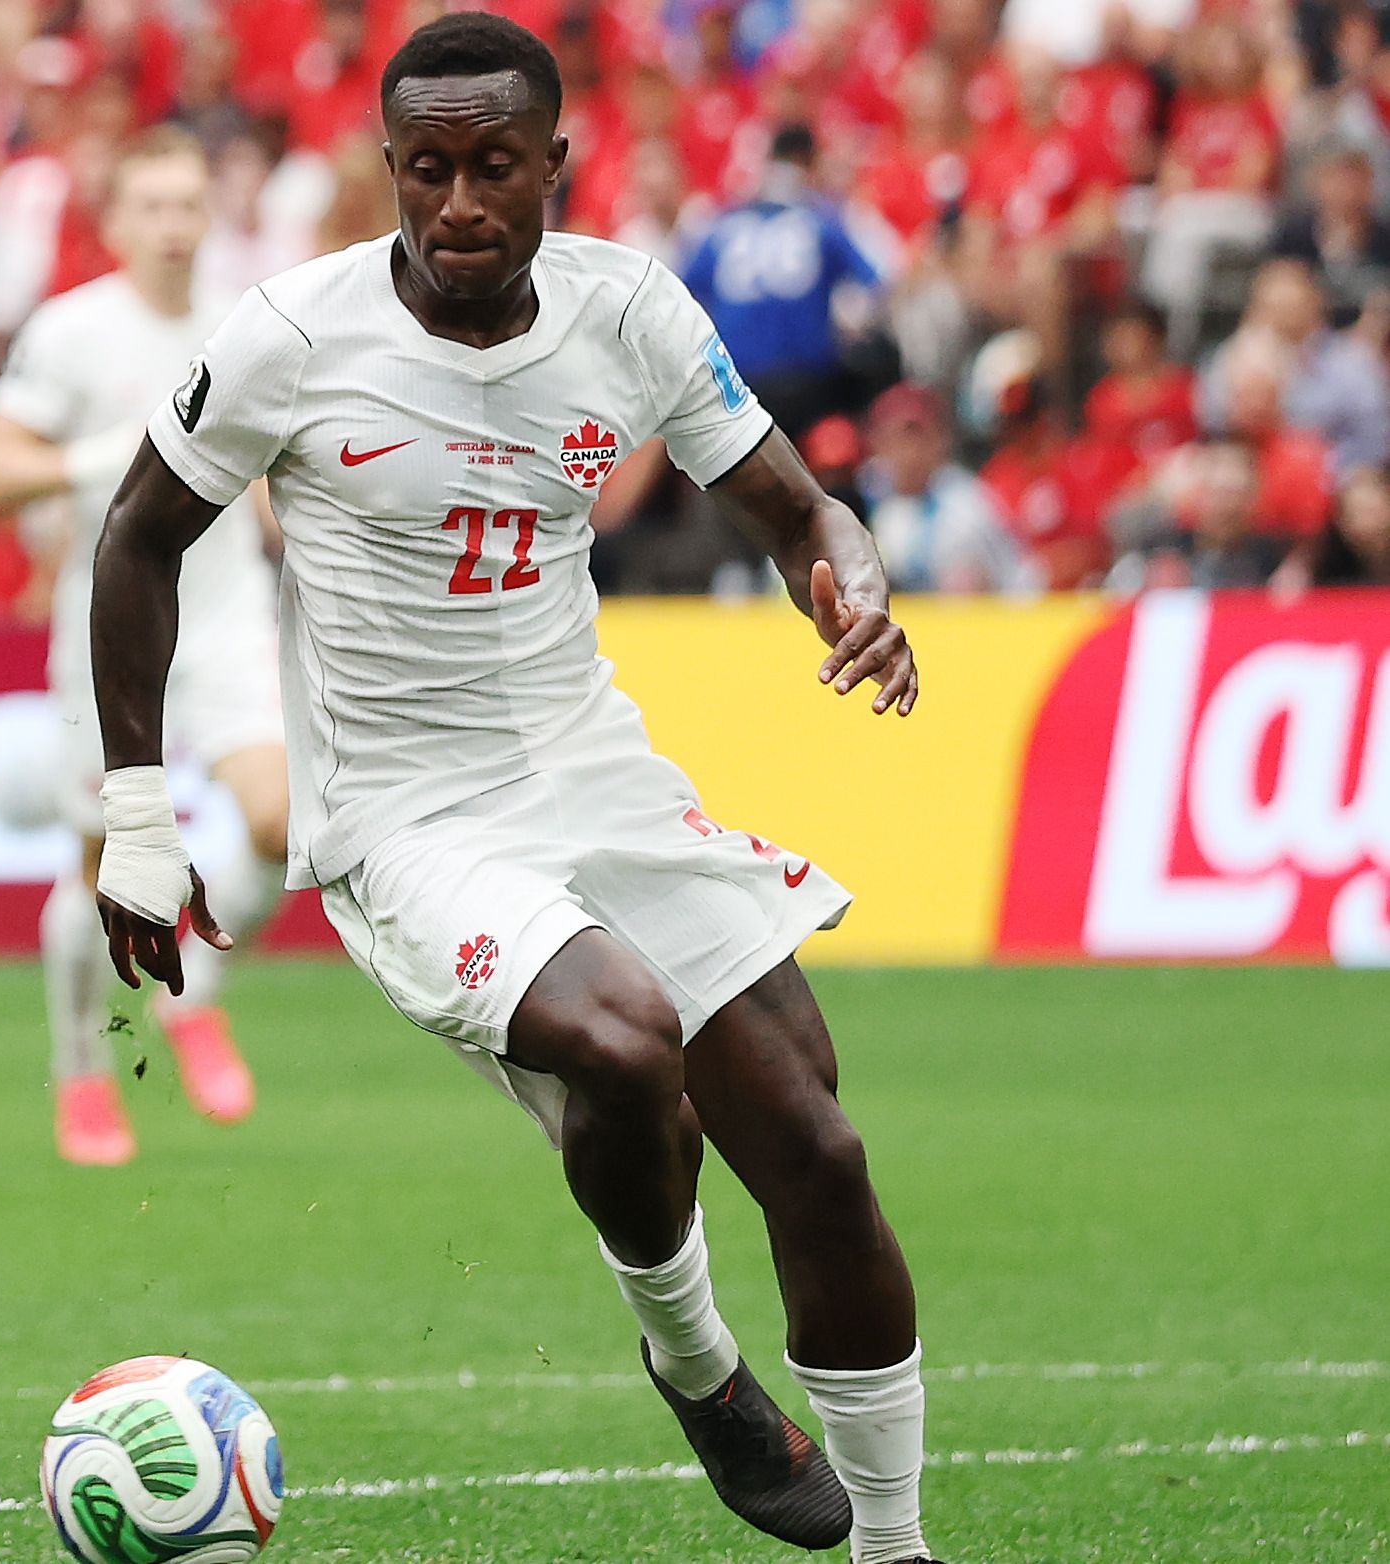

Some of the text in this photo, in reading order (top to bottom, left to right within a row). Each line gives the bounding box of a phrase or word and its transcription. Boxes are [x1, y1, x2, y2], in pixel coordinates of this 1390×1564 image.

[560, 449, 617, 462] CANADA
[442, 507, 540, 594] 22
[461, 939, 496, 986] CANADA
